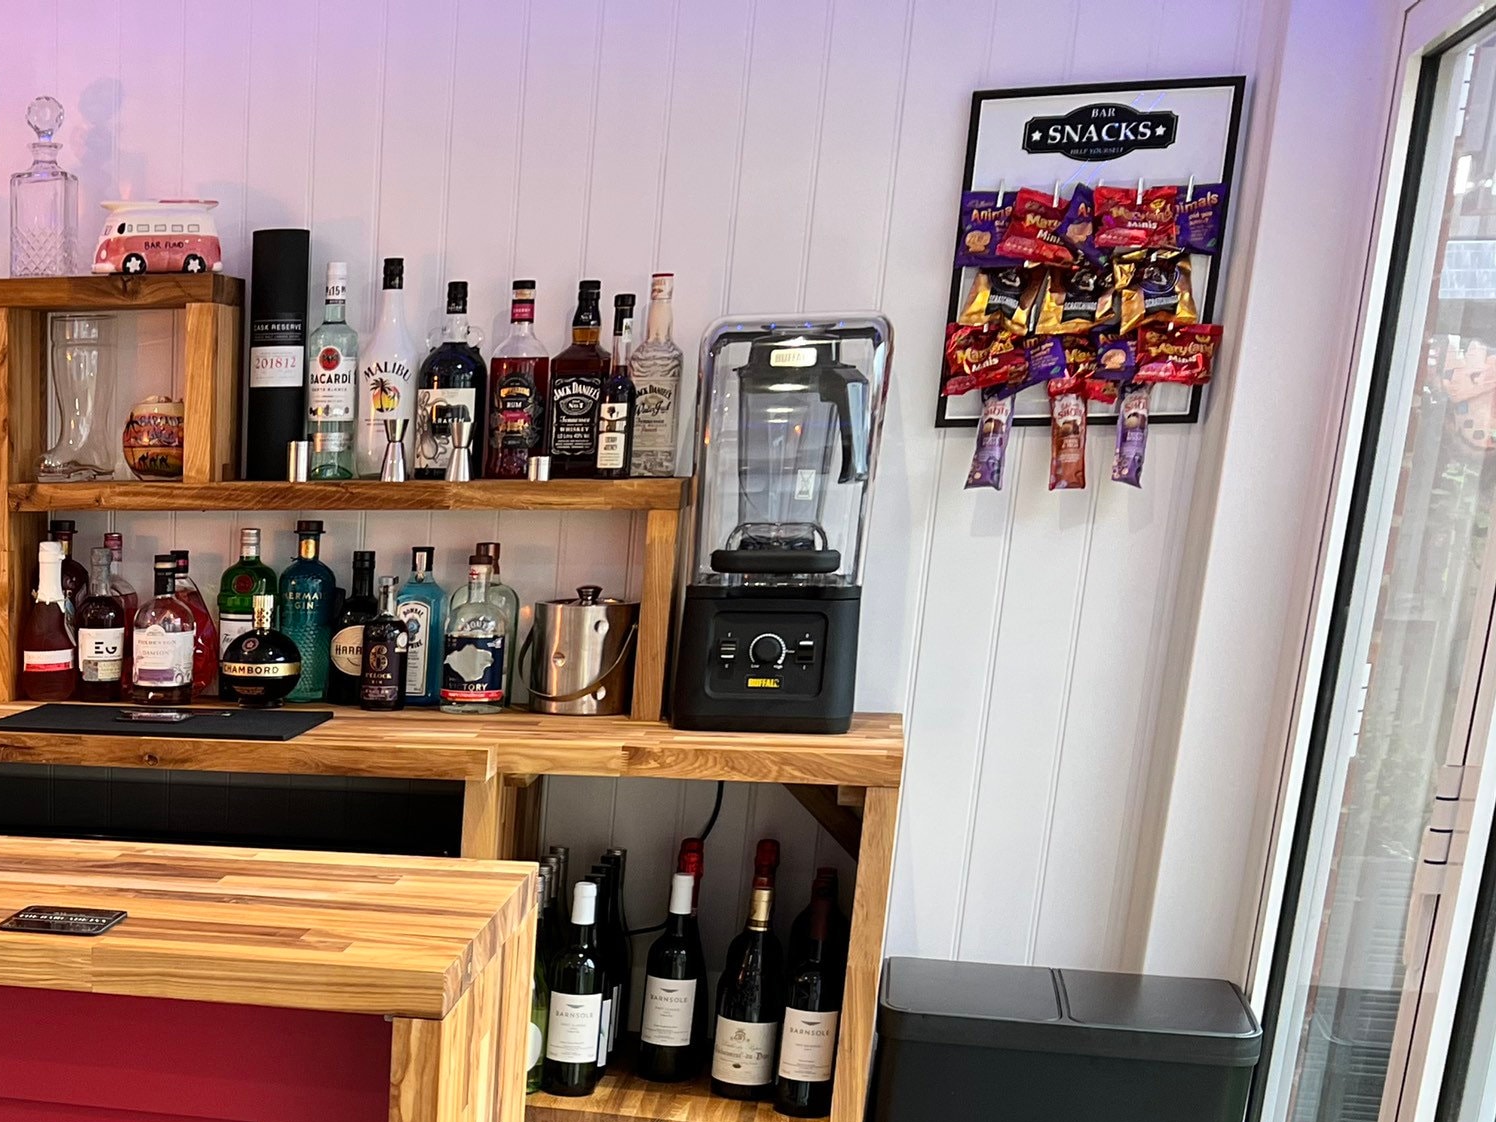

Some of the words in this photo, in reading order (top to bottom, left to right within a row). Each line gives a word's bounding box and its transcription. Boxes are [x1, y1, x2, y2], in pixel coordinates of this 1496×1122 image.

[1091, 107, 1116, 118] BAR
[1047, 121, 1152, 144] SNACKS
[144, 241, 162, 251] BAR
[271, 323, 302, 331] RESERVE
[363, 361, 412, 383] MALIBU
[554, 385, 572, 401] JACK
[507, 401, 523, 409] RUM
[224, 663, 279, 675] CHAMBORD
[650, 994, 688, 1004] BARNSOLE
[555, 1010, 593, 1019] BARNSOLE
[790, 1027, 830, 1037] BARNSOLE
